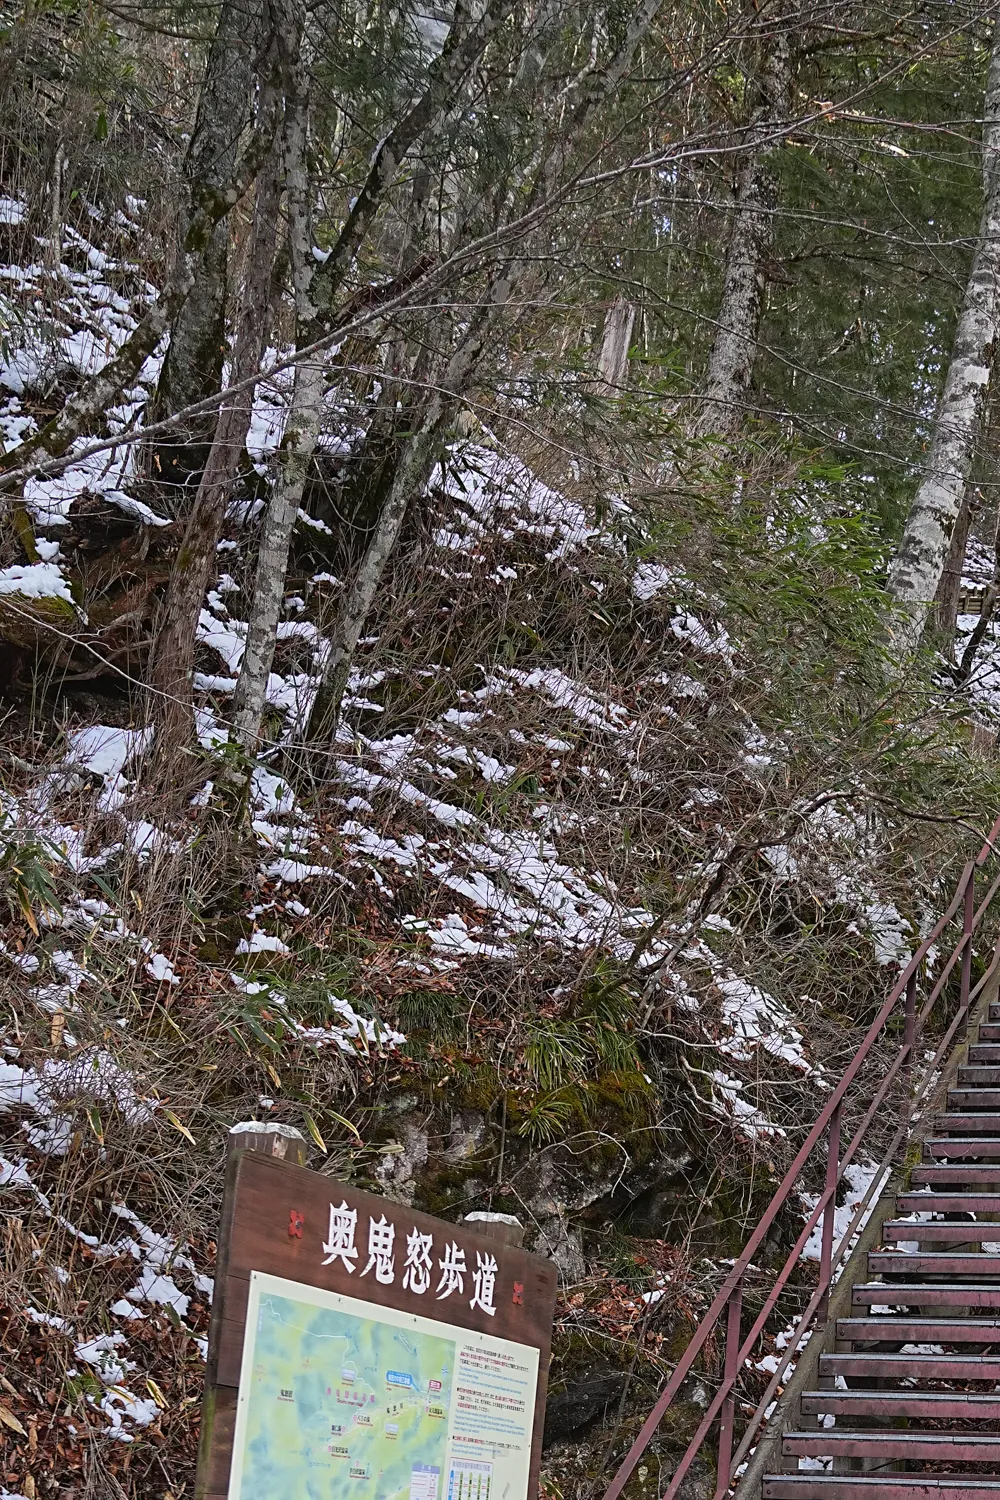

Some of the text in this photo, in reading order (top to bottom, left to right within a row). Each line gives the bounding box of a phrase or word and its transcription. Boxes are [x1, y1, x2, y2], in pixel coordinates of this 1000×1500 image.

[321, 1200, 498, 1317] 奥鬼怒歩道
